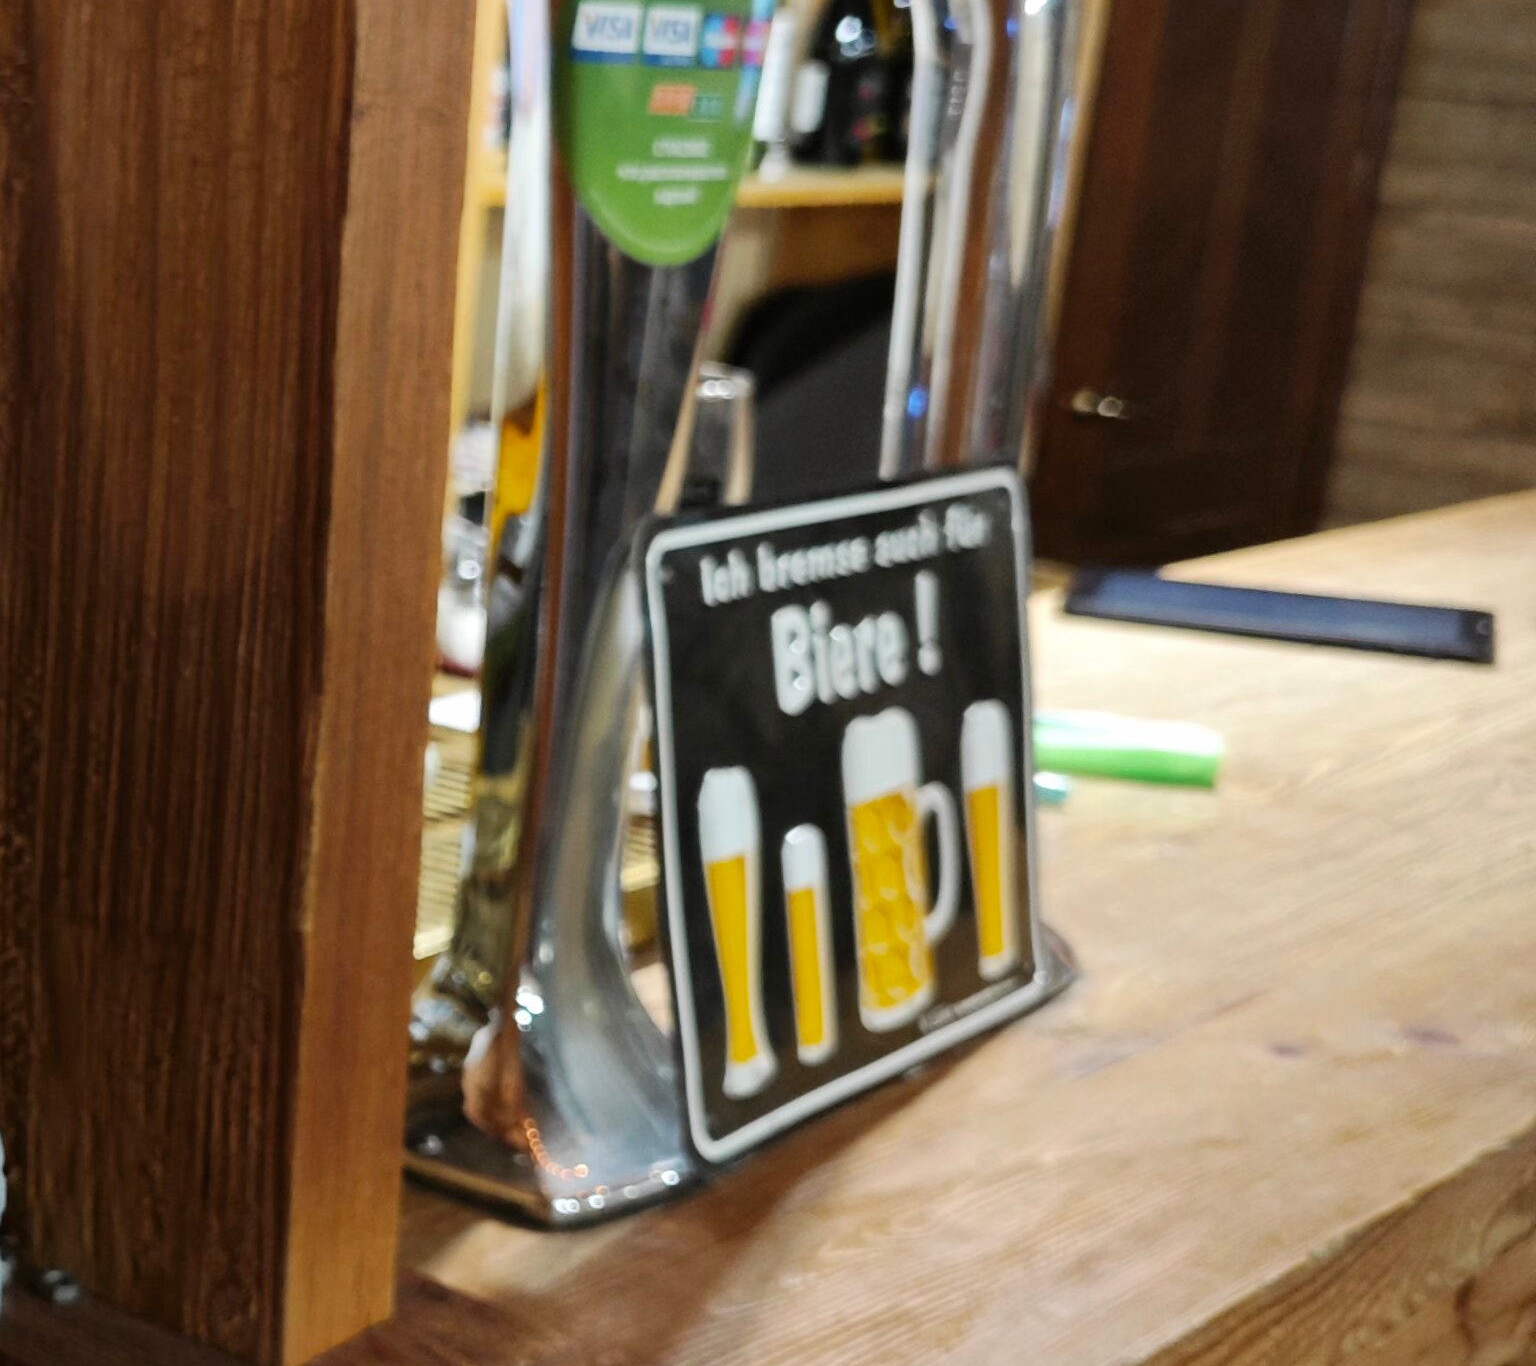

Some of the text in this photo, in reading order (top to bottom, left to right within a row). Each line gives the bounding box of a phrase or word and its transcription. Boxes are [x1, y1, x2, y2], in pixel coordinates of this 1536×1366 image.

[586, 12, 635, 39] VISA
[699, 547, 754, 606] Ich
[757, 542, 870, 592] bremse
